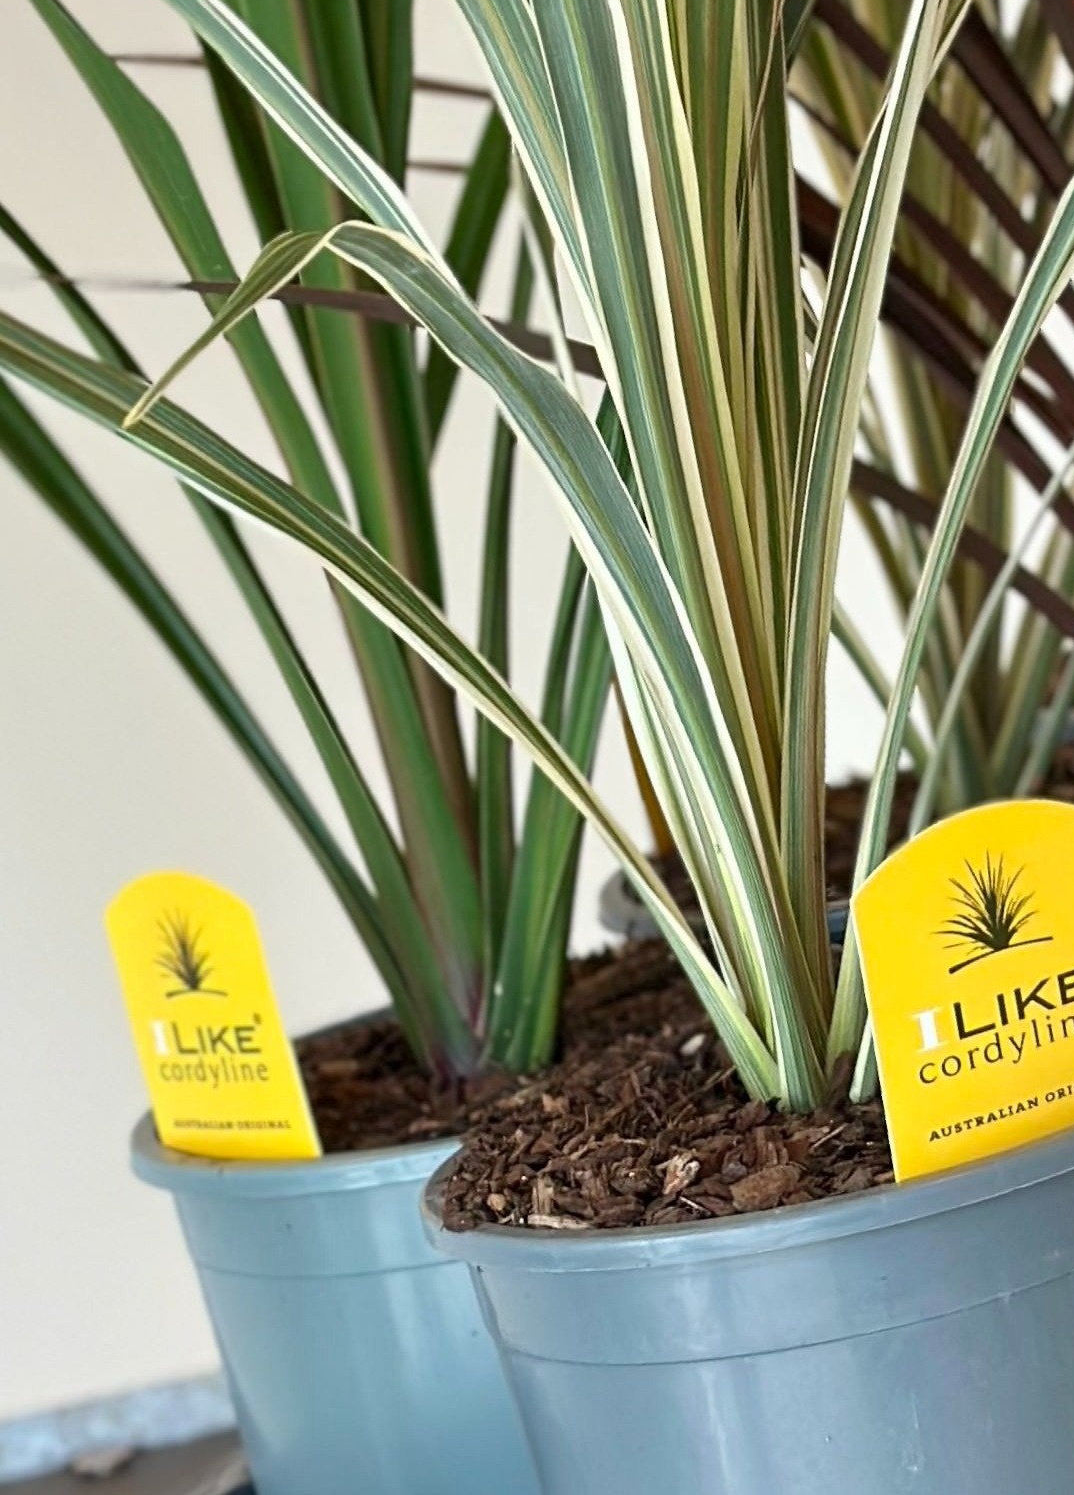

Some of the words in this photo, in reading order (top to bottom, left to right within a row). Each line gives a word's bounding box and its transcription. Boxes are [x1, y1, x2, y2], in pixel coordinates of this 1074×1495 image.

[912, 1005, 948, 1053] I
[159, 1055, 269, 1088] cordyline
[929, 1096, 1039, 1142] AUSTRALIAN
